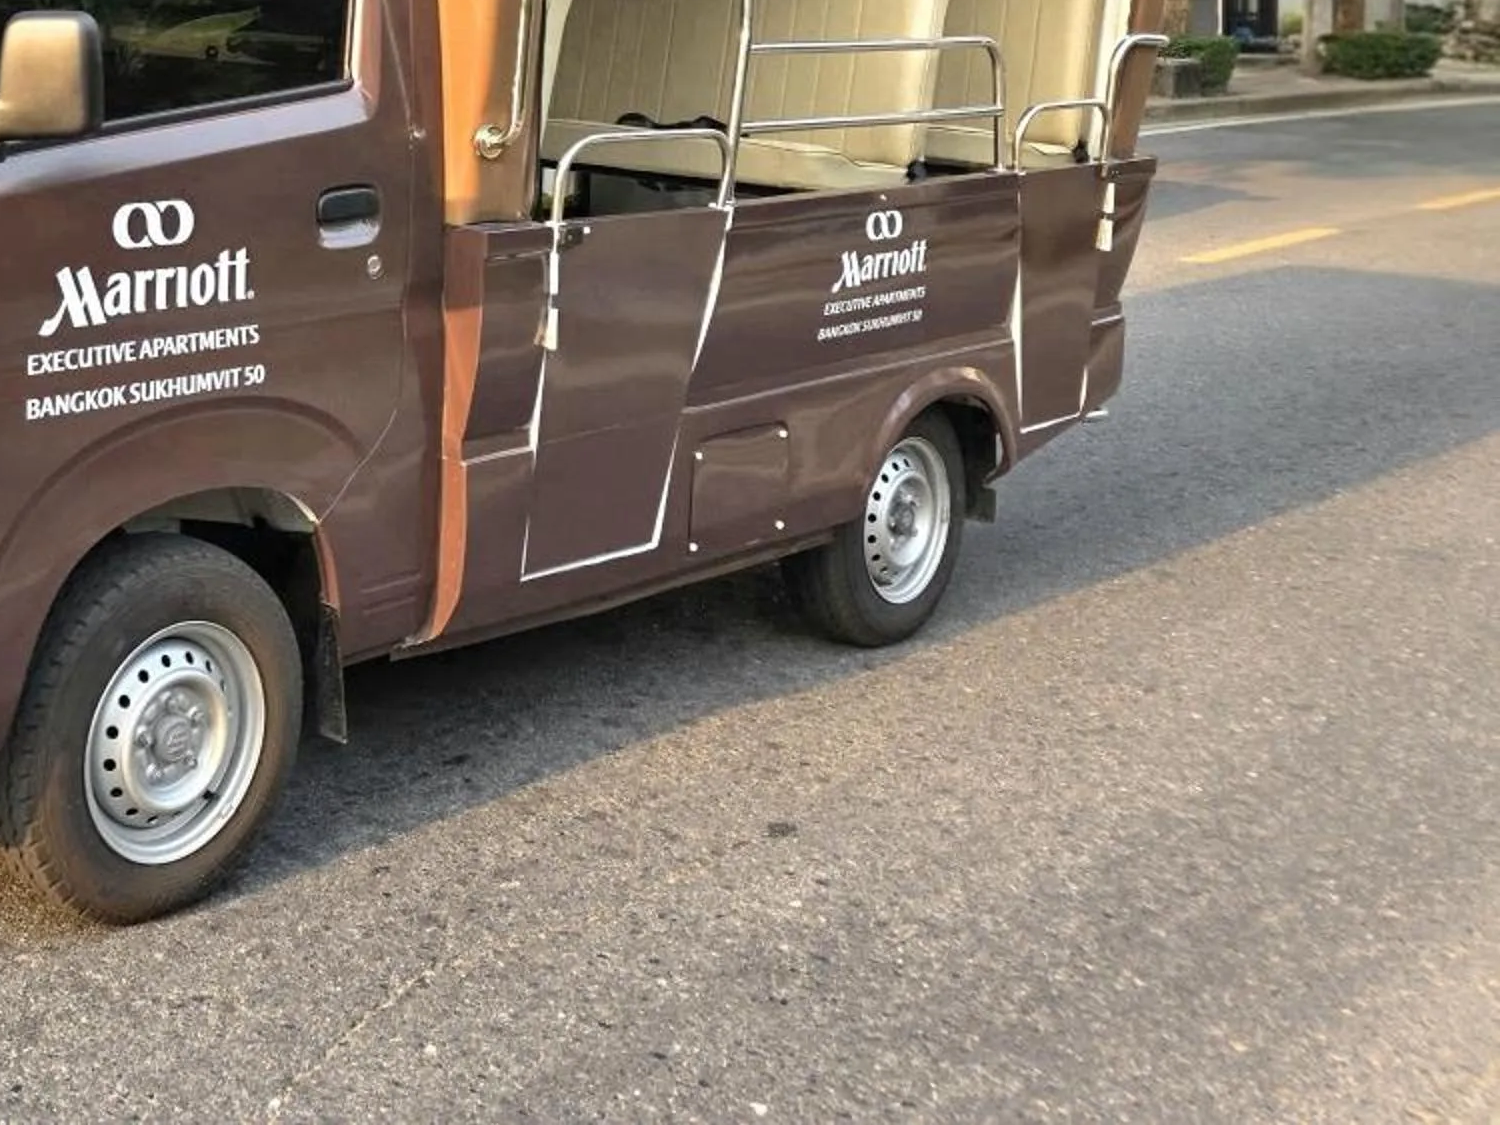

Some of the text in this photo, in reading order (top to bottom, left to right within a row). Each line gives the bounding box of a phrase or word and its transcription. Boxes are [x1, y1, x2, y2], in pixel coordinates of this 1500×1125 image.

[38, 247, 252, 337] Marriott
[831, 239, 927, 294] Marriott
[27, 324, 260, 376] EXECUTIVE APARTMENTS
[26, 364, 266, 420] BANGKOK SUKHUMVIT 50
